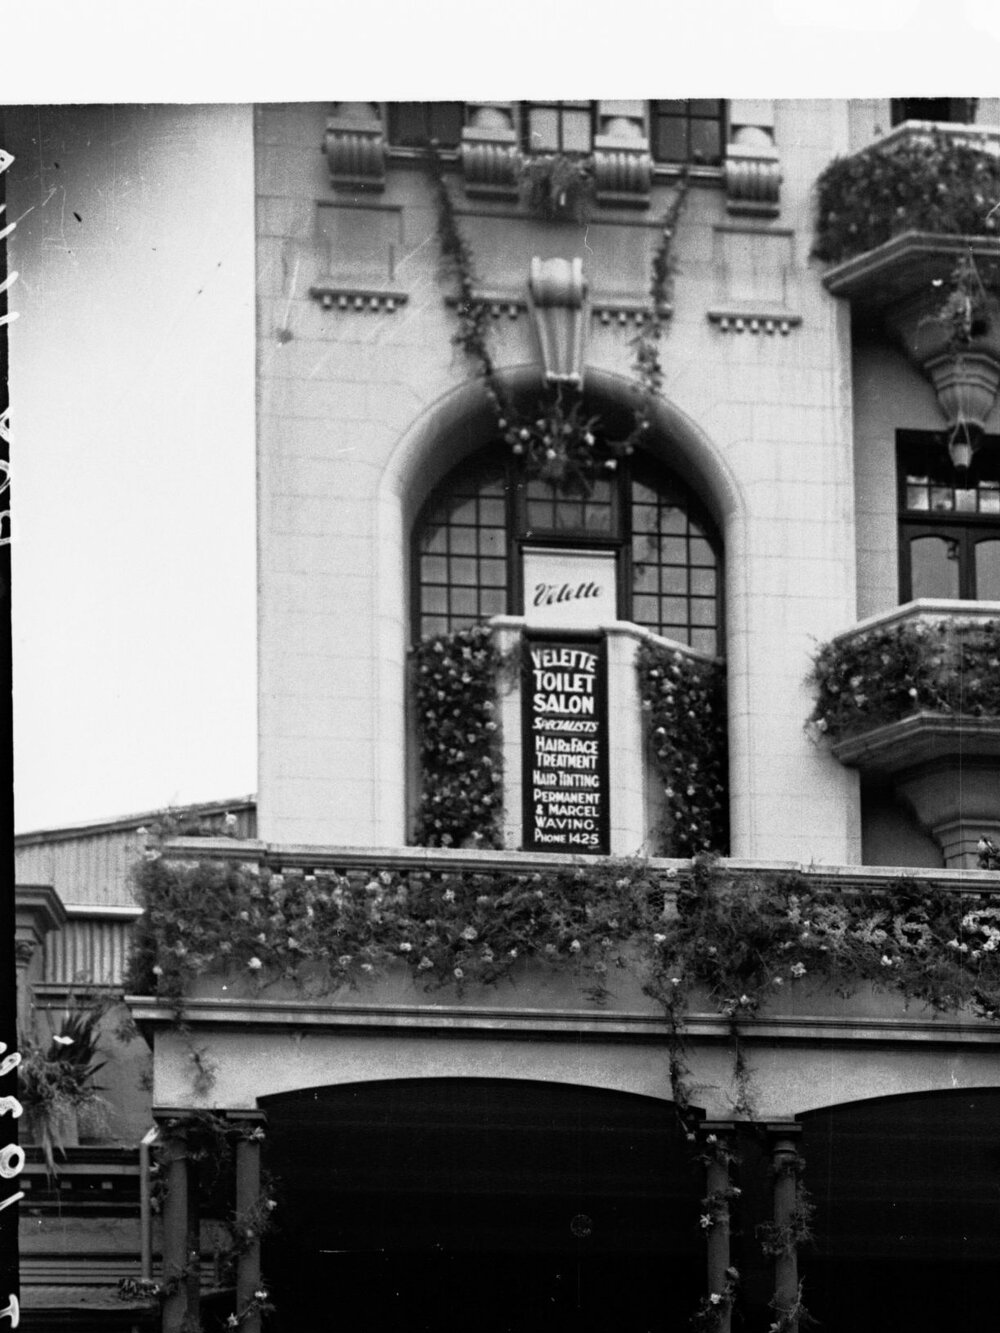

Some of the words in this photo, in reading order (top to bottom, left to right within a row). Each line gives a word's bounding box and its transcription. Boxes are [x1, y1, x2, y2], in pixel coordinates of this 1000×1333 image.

[530, 648, 599, 673] VELETTE
[532, 669, 597, 693] TOILET
[532, 693, 595, 714] SALON
[536, 752, 598, 769] TREATMENT
[533, 769, 557, 785] HAIR
[557, 770, 600, 788] TINTING
[533, 788, 600, 805] PERMANENT
[535, 804, 544, 815] &
[548, 803, 600, 817] MARCEL
[534, 828, 567, 843] PHONE
[569, 832, 599, 845] 1425
